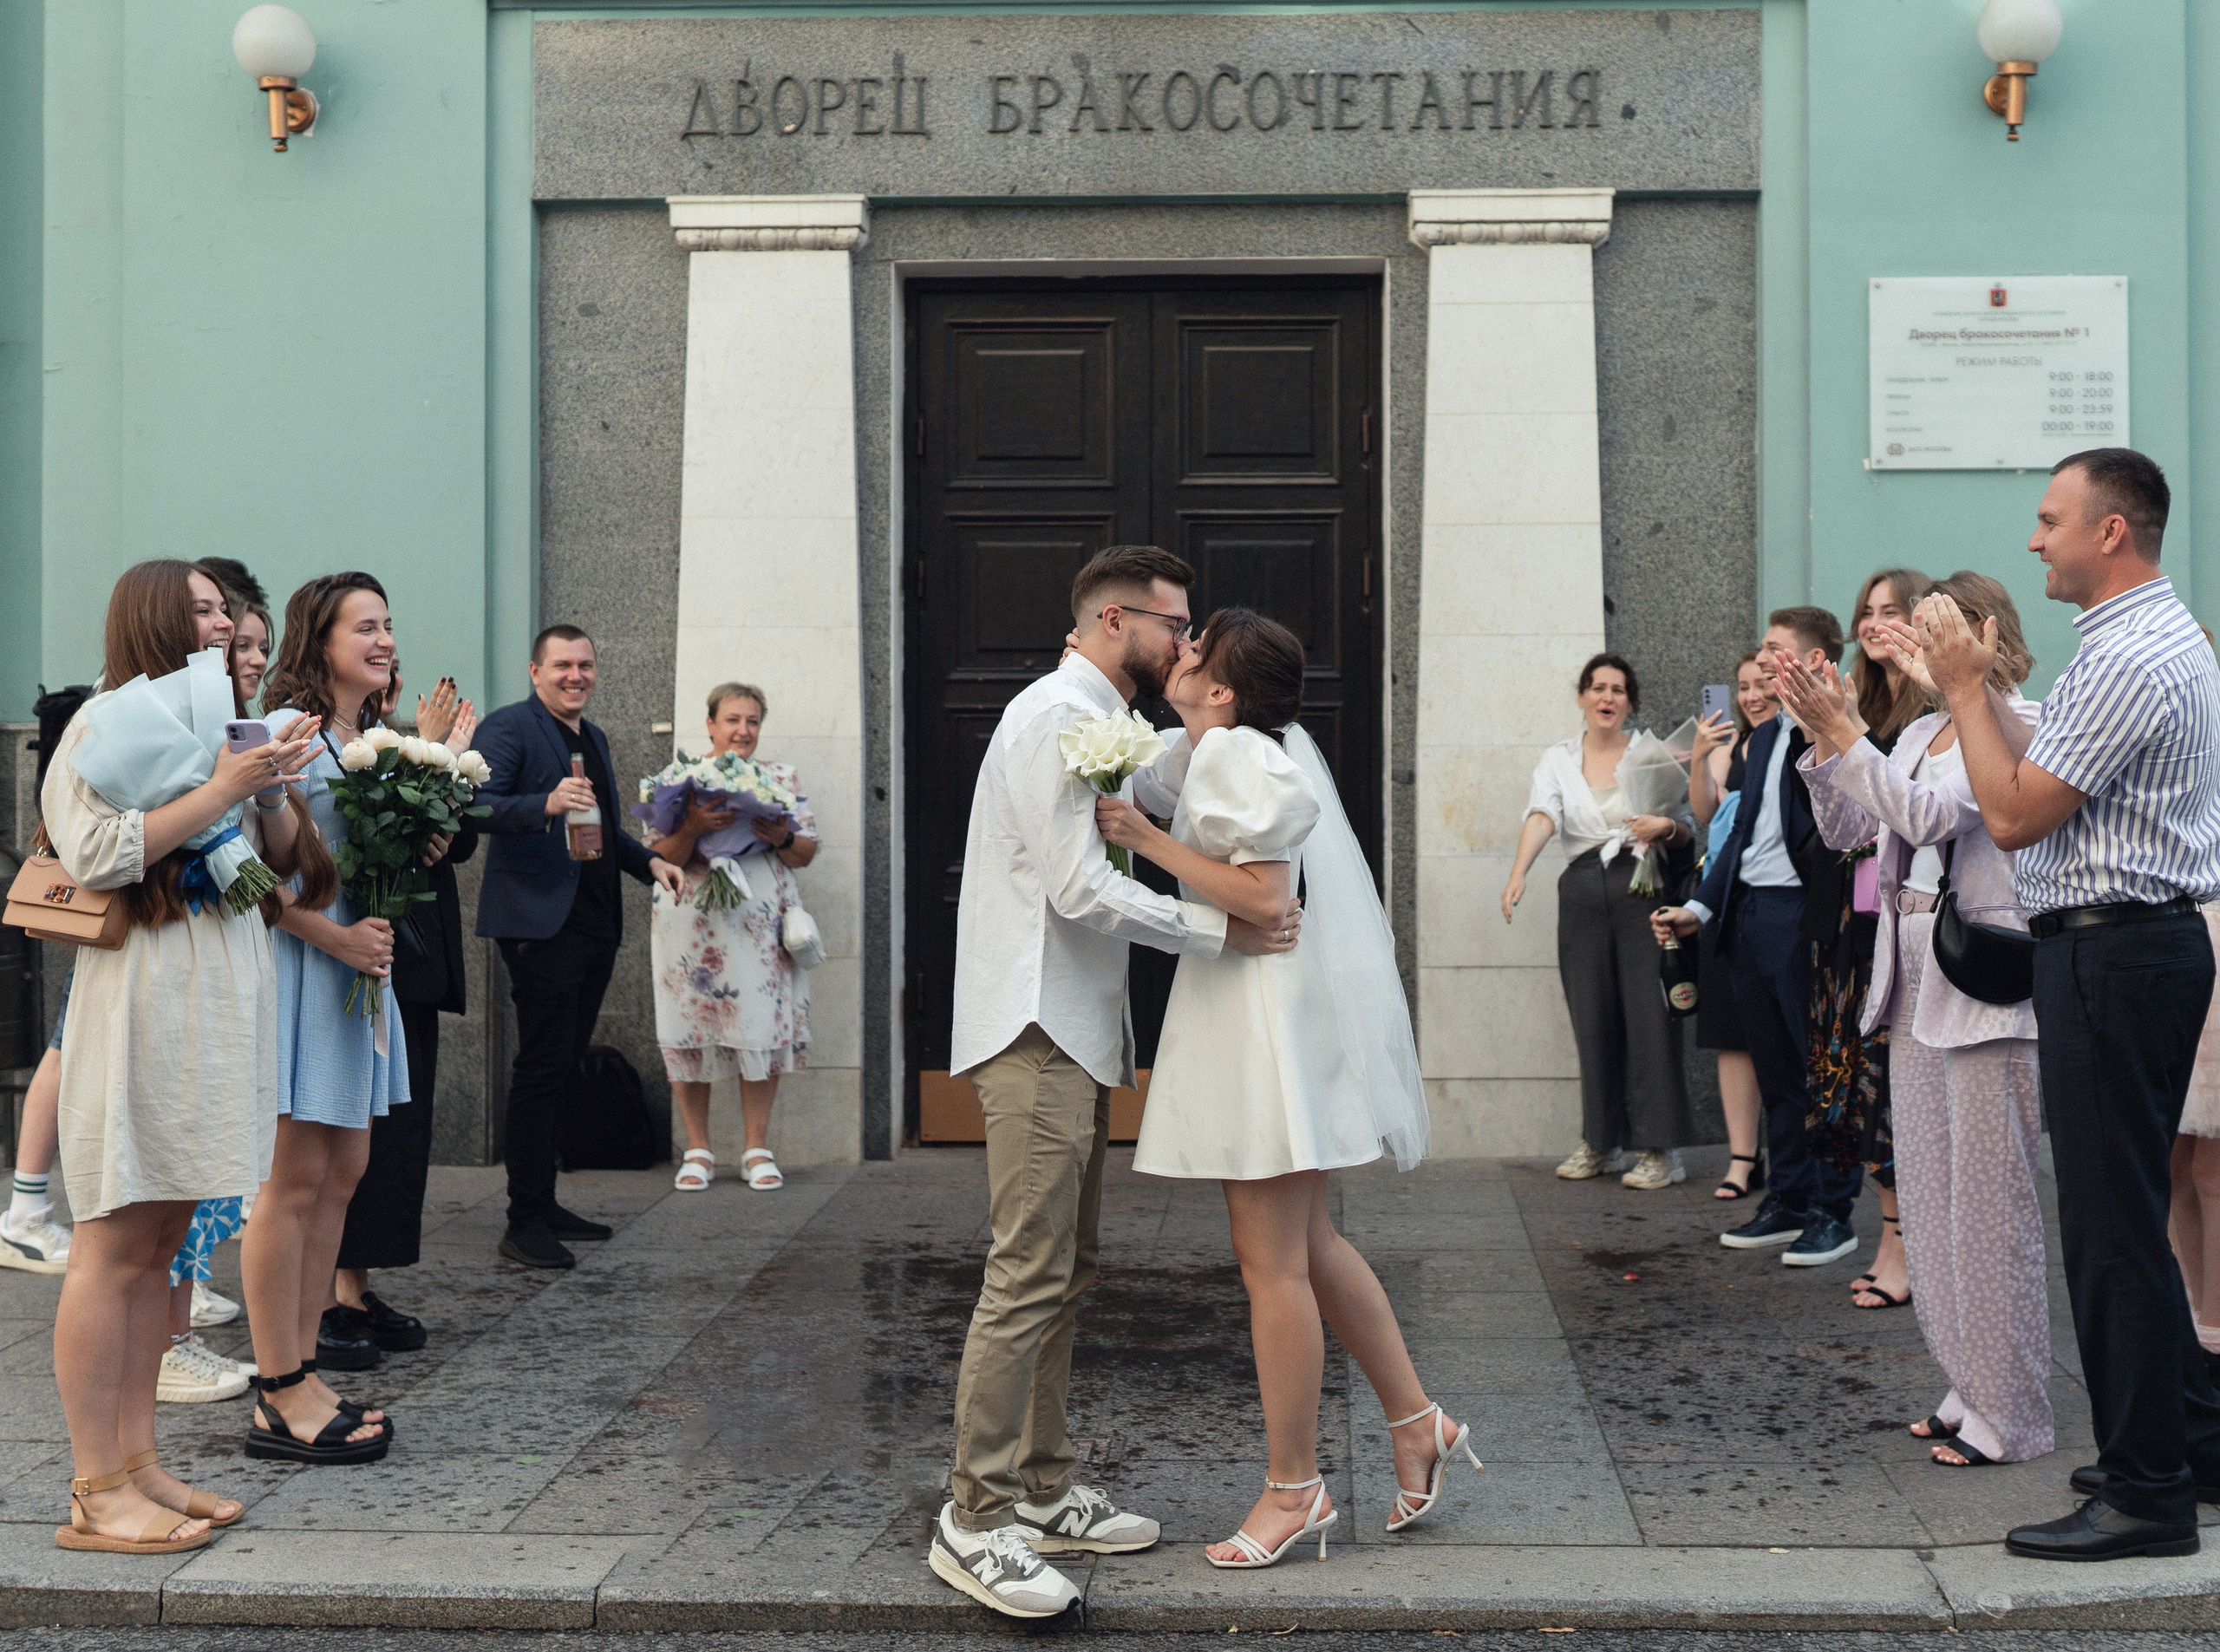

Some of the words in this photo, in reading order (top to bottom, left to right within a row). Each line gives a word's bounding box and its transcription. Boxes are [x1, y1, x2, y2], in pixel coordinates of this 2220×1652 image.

[680, 73, 933, 142] ДВОРЕЦ
[987, 69, 1604, 134] БРАКОСОЧЕТАНИЯ
[1909, 328, 1957, 342] Дворец
[1959, 327, 2061, 342] бракосочетания
[2084, 327, 2091, 337] 1
[1956, 356, 1997, 366] РЕЖИМ
[2000, 356, 2042, 366] РАБОТЫ
